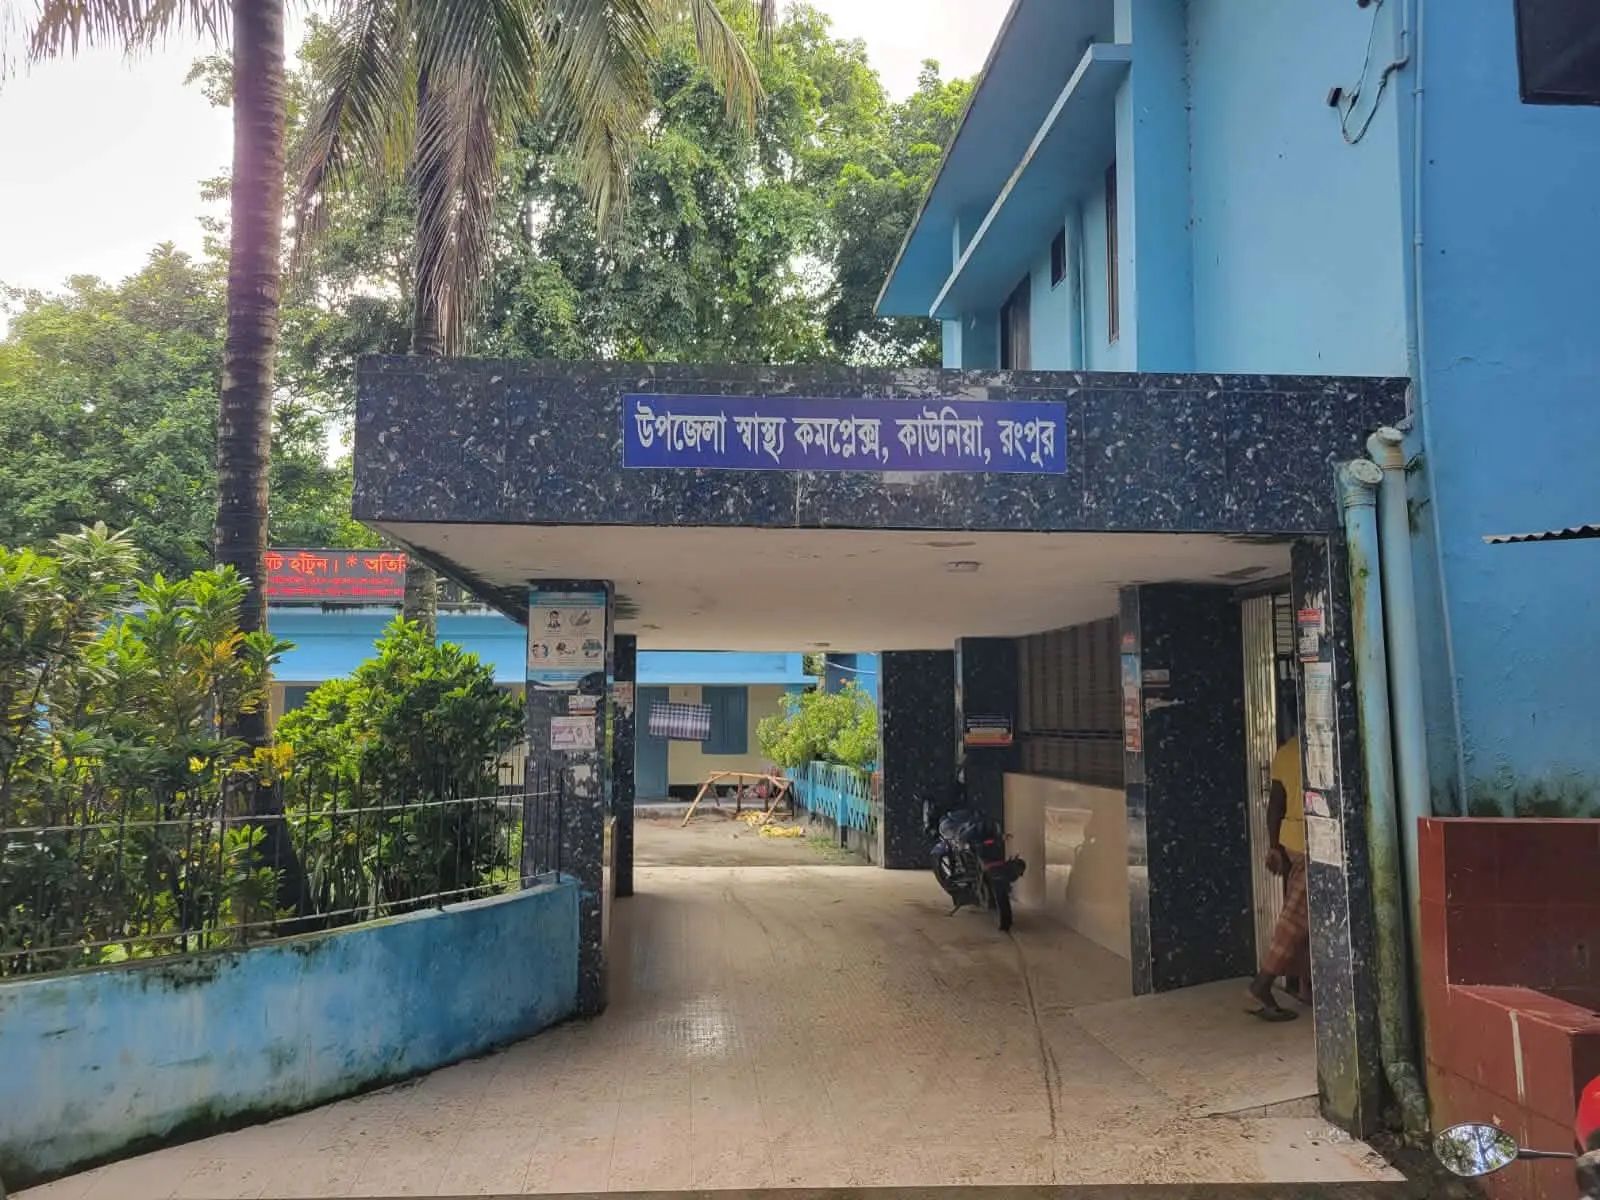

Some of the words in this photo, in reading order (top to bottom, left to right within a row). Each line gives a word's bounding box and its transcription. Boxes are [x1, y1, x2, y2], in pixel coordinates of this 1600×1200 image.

[634, 401, 727, 455] উপজেলা
[733, 411, 787, 464] স্বাস্থ্য
[792, 414, 889, 464] কমপ্লেক্স,
[896, 406, 991, 464] কাউনিয়া,
[997, 416, 1057, 468] রংপুর
